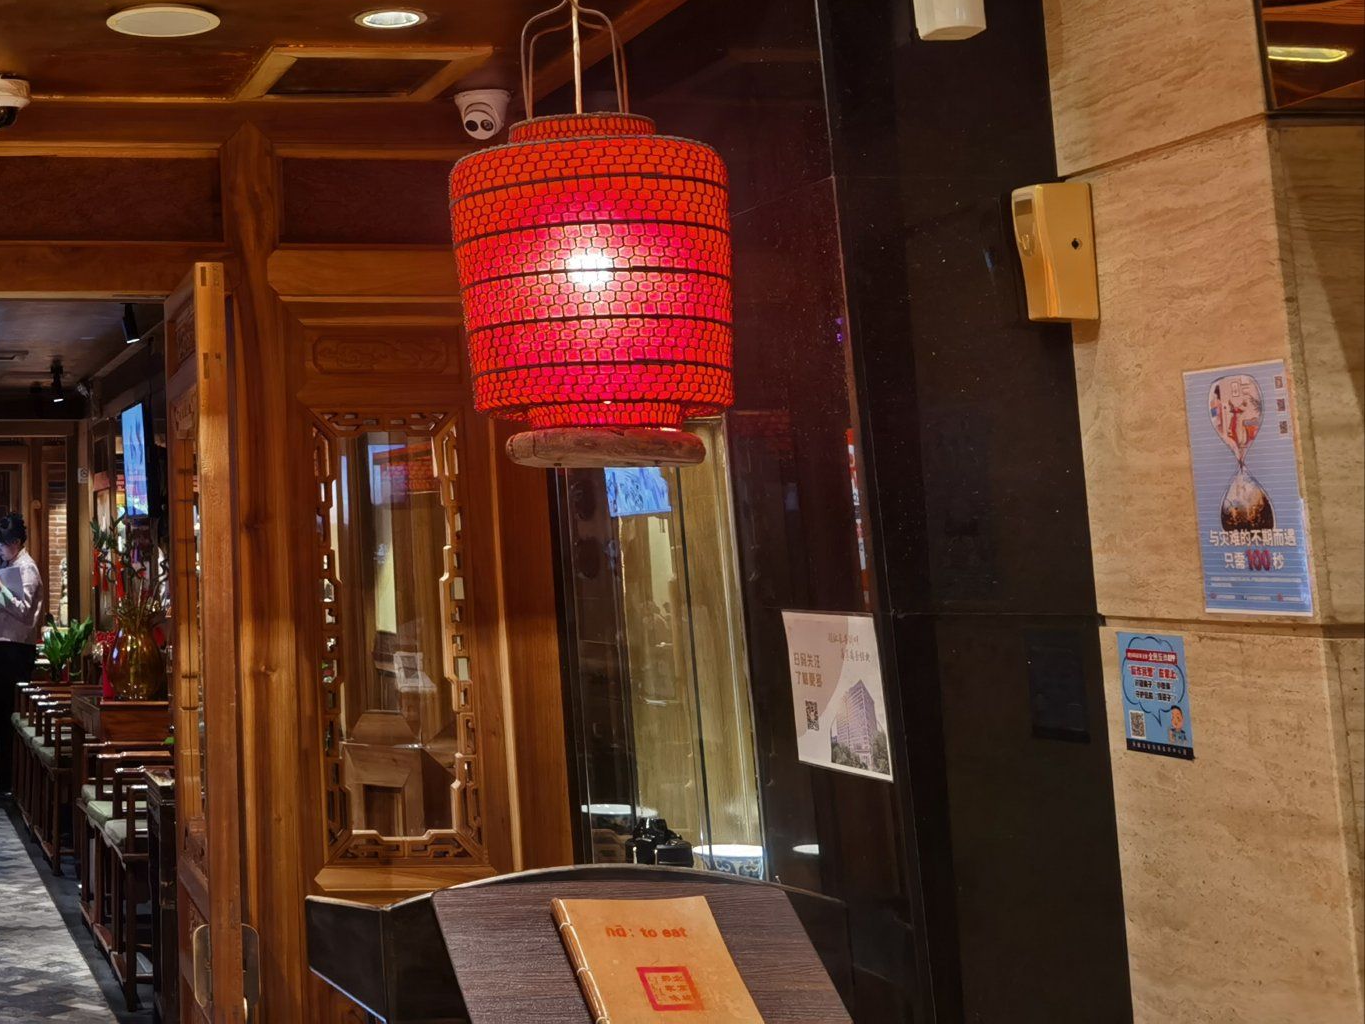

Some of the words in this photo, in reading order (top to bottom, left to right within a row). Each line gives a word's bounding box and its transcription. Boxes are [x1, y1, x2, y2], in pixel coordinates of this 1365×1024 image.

[1209, 528, 1296, 547] 与灾难的不期而遇
[1224, 549, 1285, 572] 只需100秒
[640, 927, 658, 938] to
[662, 927, 688, 938] eat
